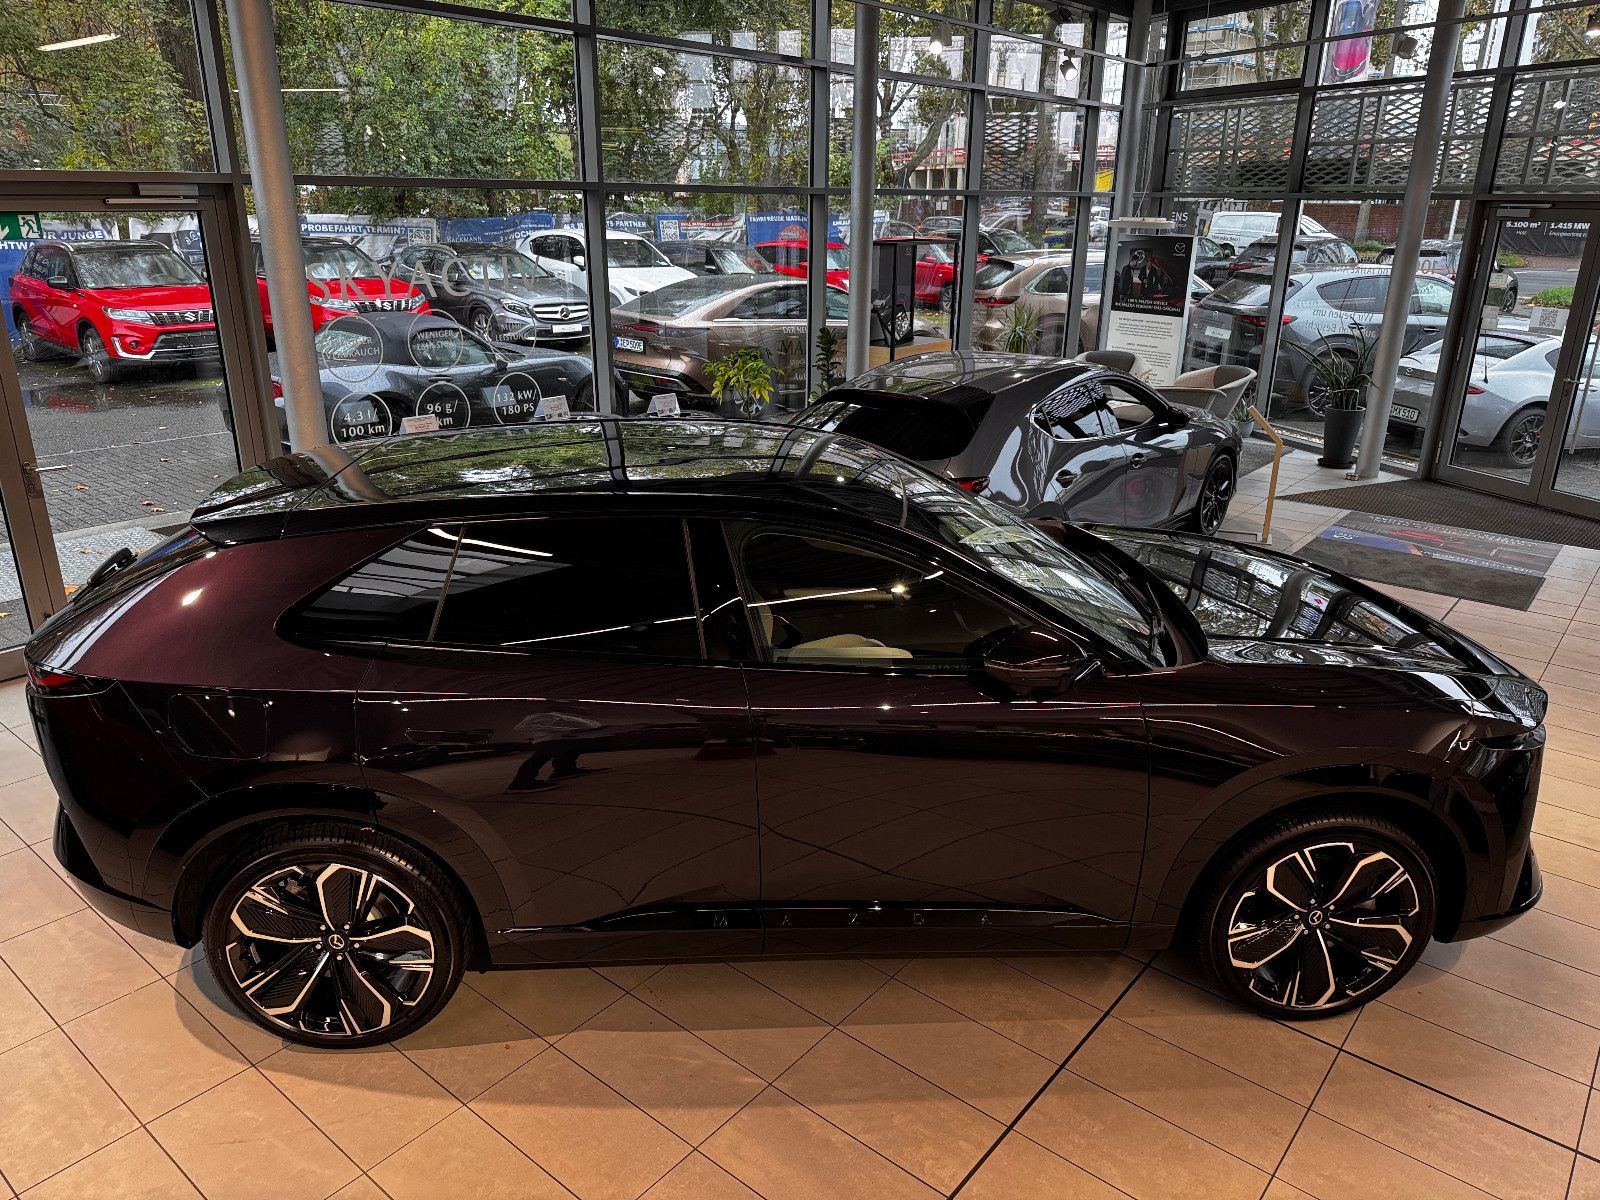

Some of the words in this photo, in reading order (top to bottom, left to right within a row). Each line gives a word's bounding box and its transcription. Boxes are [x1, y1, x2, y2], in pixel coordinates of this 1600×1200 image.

[301, 223, 363, 233] PROBEFAHRT
[365, 225, 406, 235] TERMIN?
[615, 220, 647, 228] PARTNER
[61, 230, 104, 240] JUNGE
[306, 255, 540, 306] SKYACTIV
[496, 390, 515, 402] 132
[426, 403, 442, 413] 96
[501, 404, 521, 416] 180
[523, 403, 535, 413] PS
[1402, 408, 1416, 420] 510
[343, 409, 363, 424] 4,3
[341, 426, 365, 438] 100
[367, 422, 385, 434] km
